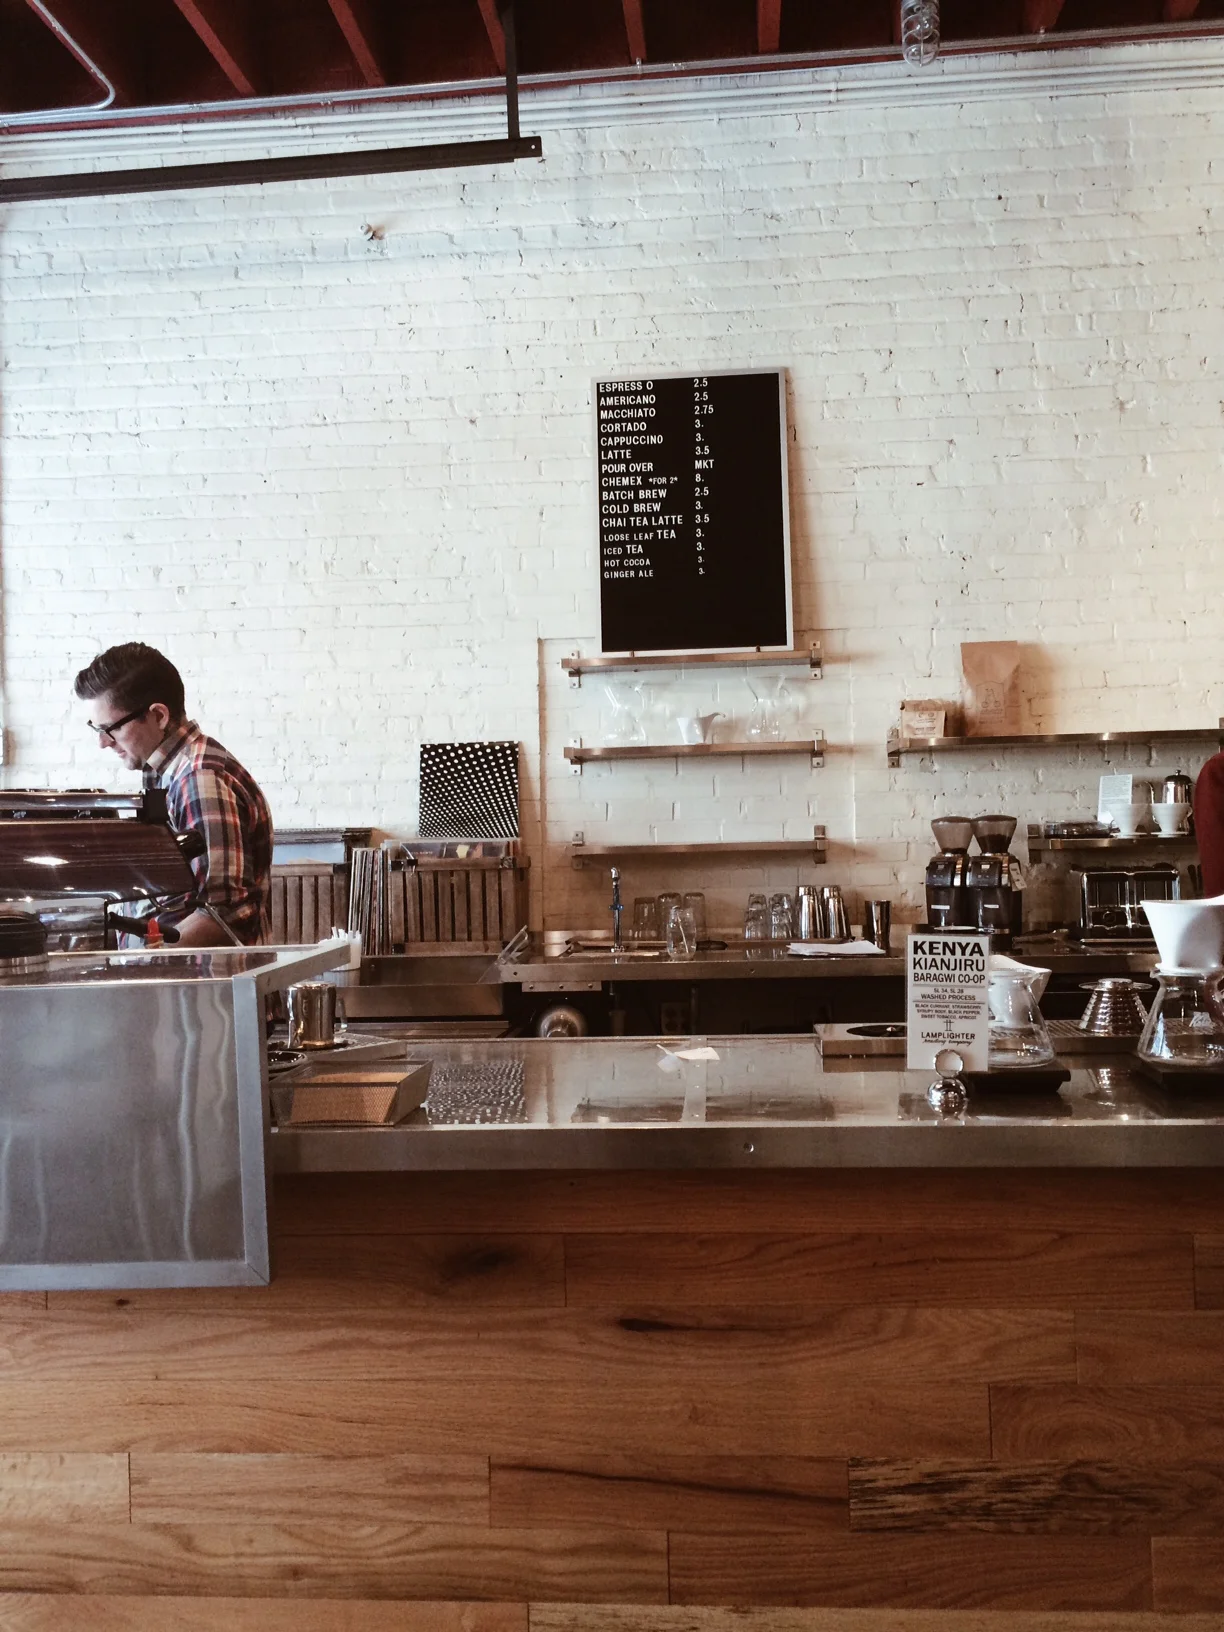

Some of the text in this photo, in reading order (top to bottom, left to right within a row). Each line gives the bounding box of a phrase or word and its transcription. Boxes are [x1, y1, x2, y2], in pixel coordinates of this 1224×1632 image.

[693, 378, 708, 388] 2.5
[599, 395, 656, 406] AMERICANO
[693, 391, 709, 402] 2.5
[600, 408, 656, 419] MACCHIATO
[694, 404, 714, 415] 2.75
[601, 421, 647, 433] CORTADO
[694, 418, 704, 429] 3.
[601, 435, 664, 446] CAPPUCCINO
[695, 432, 705, 443] 3.
[601, 449, 632, 460] LATTE
[695, 445, 710, 456] 3.5
[601, 462, 654, 474] POUR OVER
[694, 459, 715, 470] MKT
[601, 476, 643, 487] CHEMEX
[602, 488, 667, 501] BATCH BREW
[694, 486, 710, 497] 2.5
[602, 502, 662, 515] COLD BREW
[602, 515, 684, 528] CHAI TEA LATTE
[695, 513, 710, 524] 3.5
[603, 529, 677, 542] LOOSE LEAF TEA
[603, 544, 644, 556] ICED TEA
[604, 558, 651, 568] HOT COCOA
[603, 569, 654, 580] GINGER ALE
[913, 941, 985, 957] KENYA
[913, 957, 985, 972] KIANJIRU
[913, 972, 986, 984] BARAGWI CO-OP
[921, 1032, 976, 1040] LAMPLIGHTER
